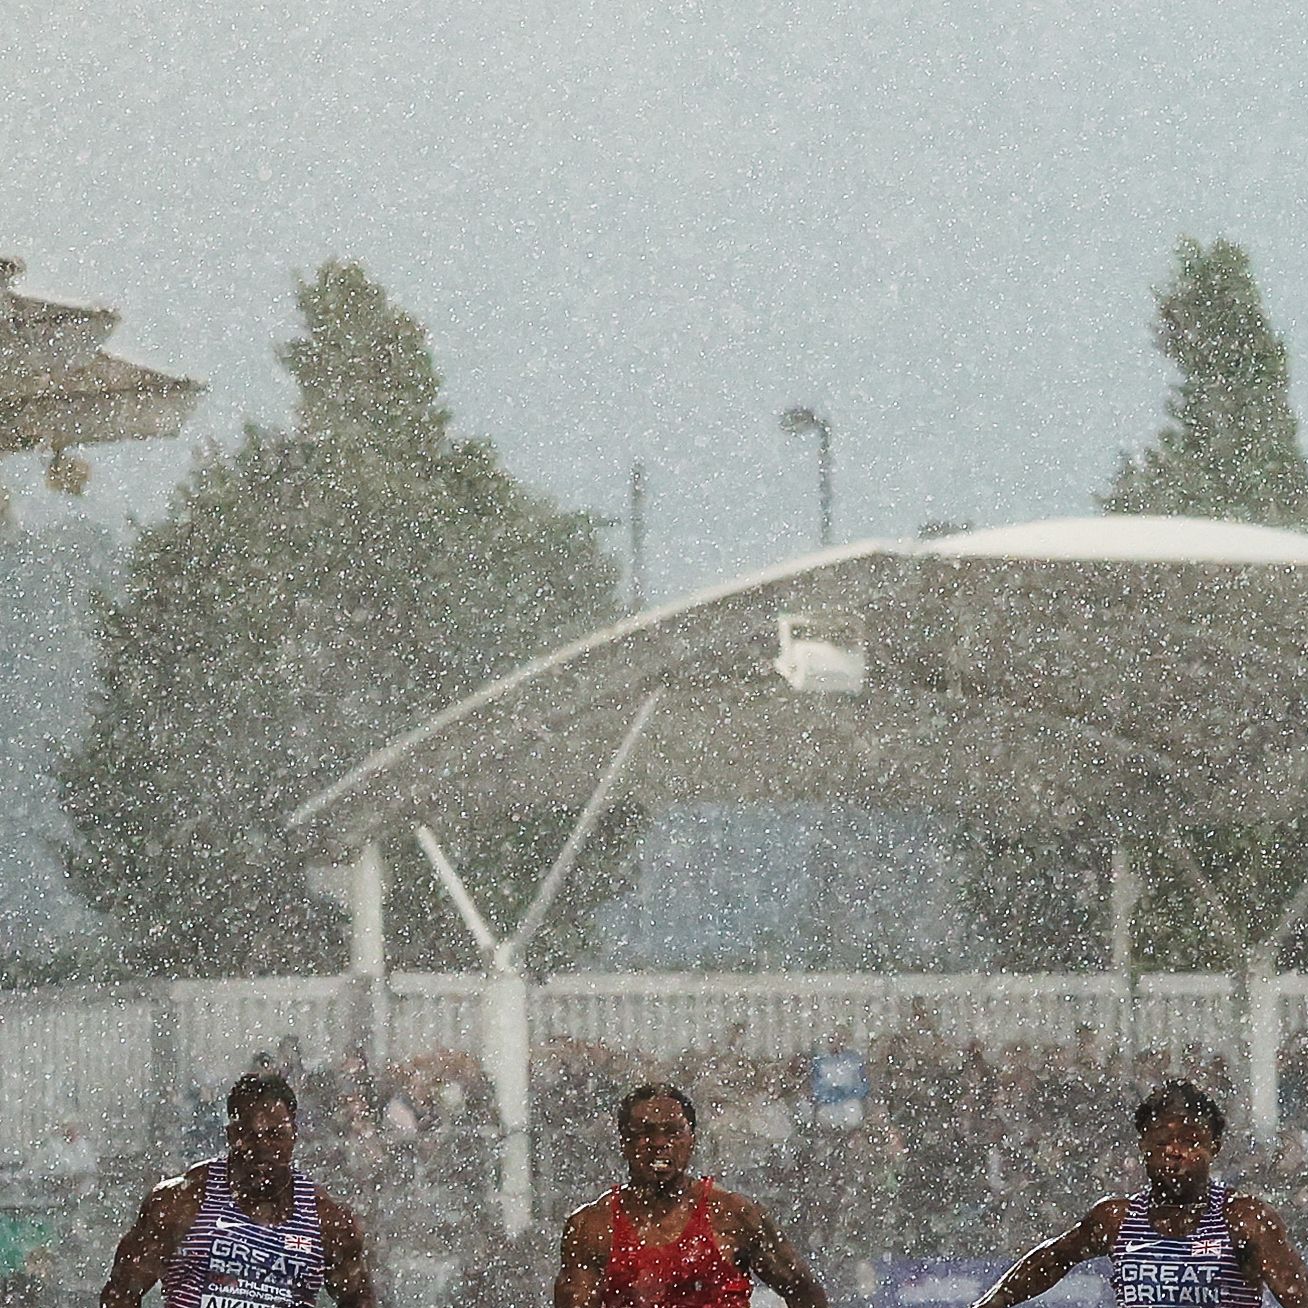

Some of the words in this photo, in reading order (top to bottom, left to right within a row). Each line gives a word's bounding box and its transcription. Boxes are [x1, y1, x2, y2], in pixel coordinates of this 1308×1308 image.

[212, 1238, 307, 1278] GREAT
[209, 1258, 294, 1285] BRITA
[1121, 1264, 1220, 1284] GREAT
[1123, 1283, 1220, 1303] BRITAIN
